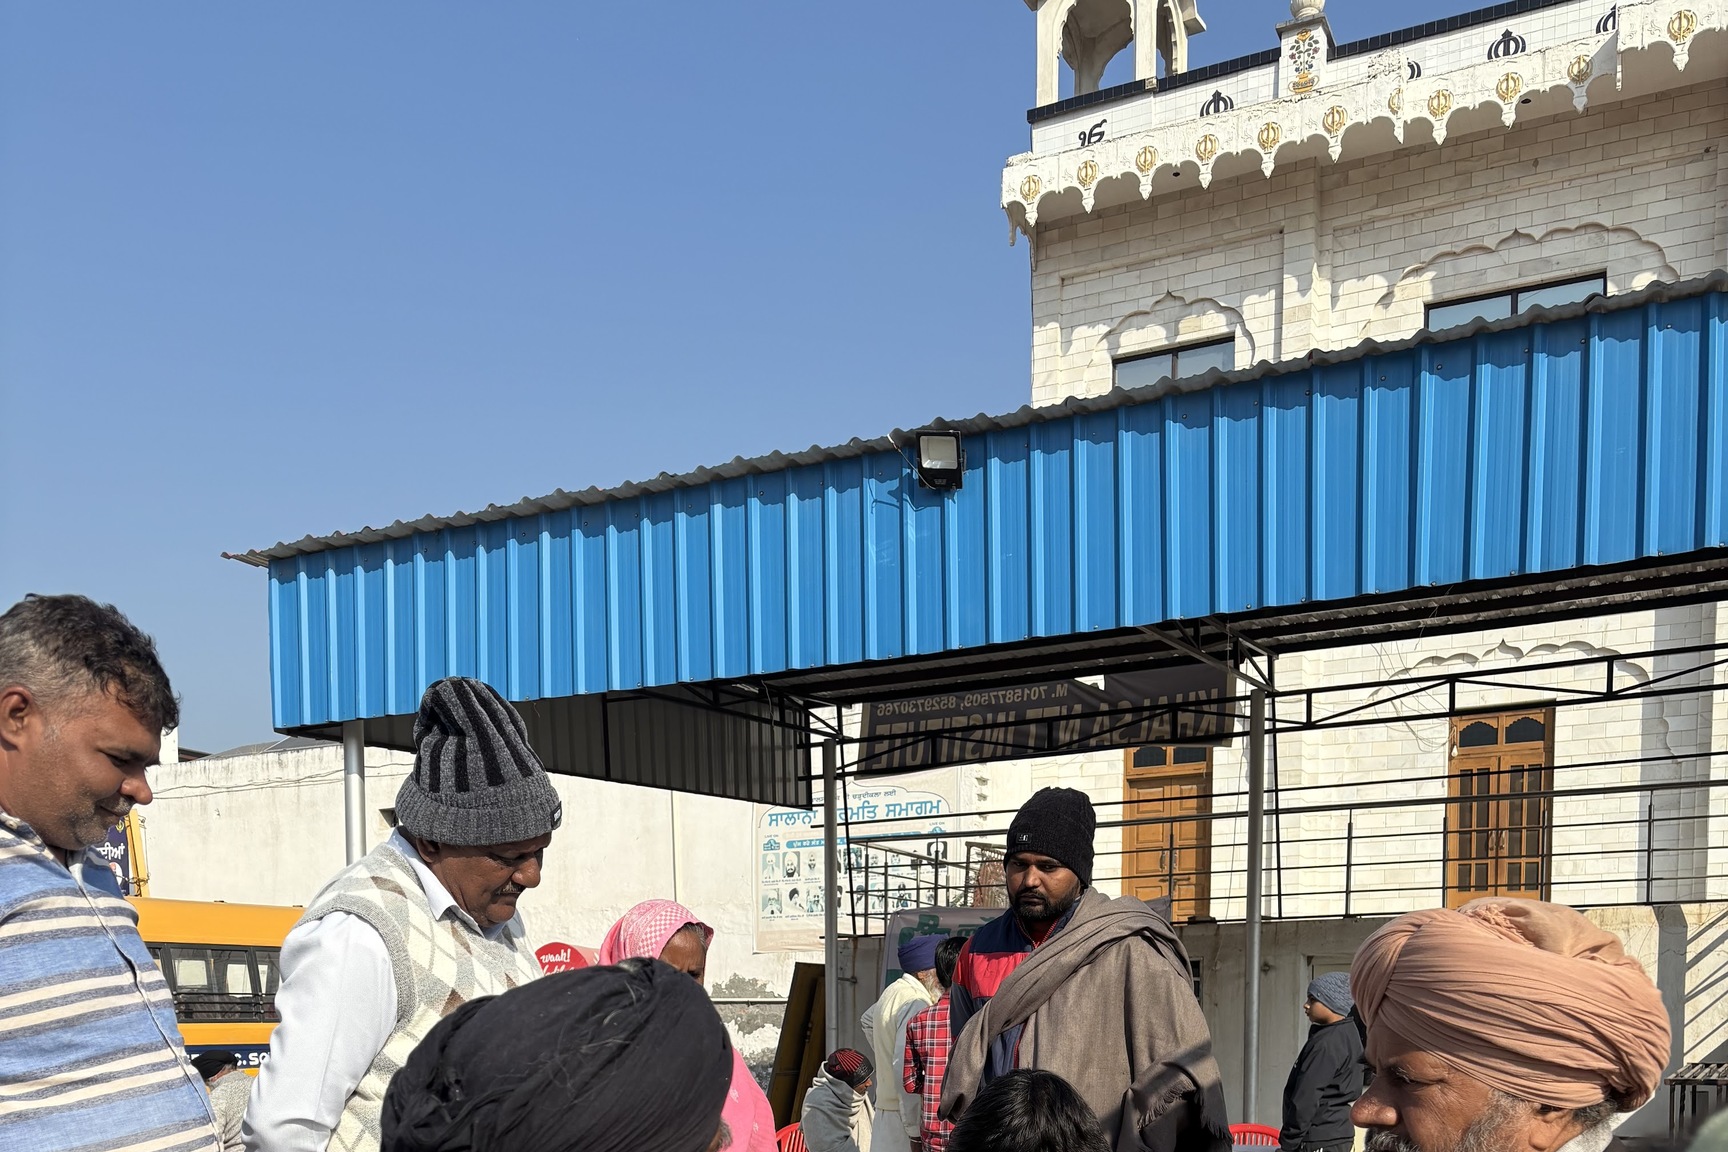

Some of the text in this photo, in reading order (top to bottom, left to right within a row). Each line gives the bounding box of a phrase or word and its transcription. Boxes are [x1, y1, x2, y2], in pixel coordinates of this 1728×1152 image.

[838, 800, 879, 822] ਰਮਤਿ
[885, 799, 942, 818] ਸਮਾਗਮ
[540, 948, 571, 963] waah!
